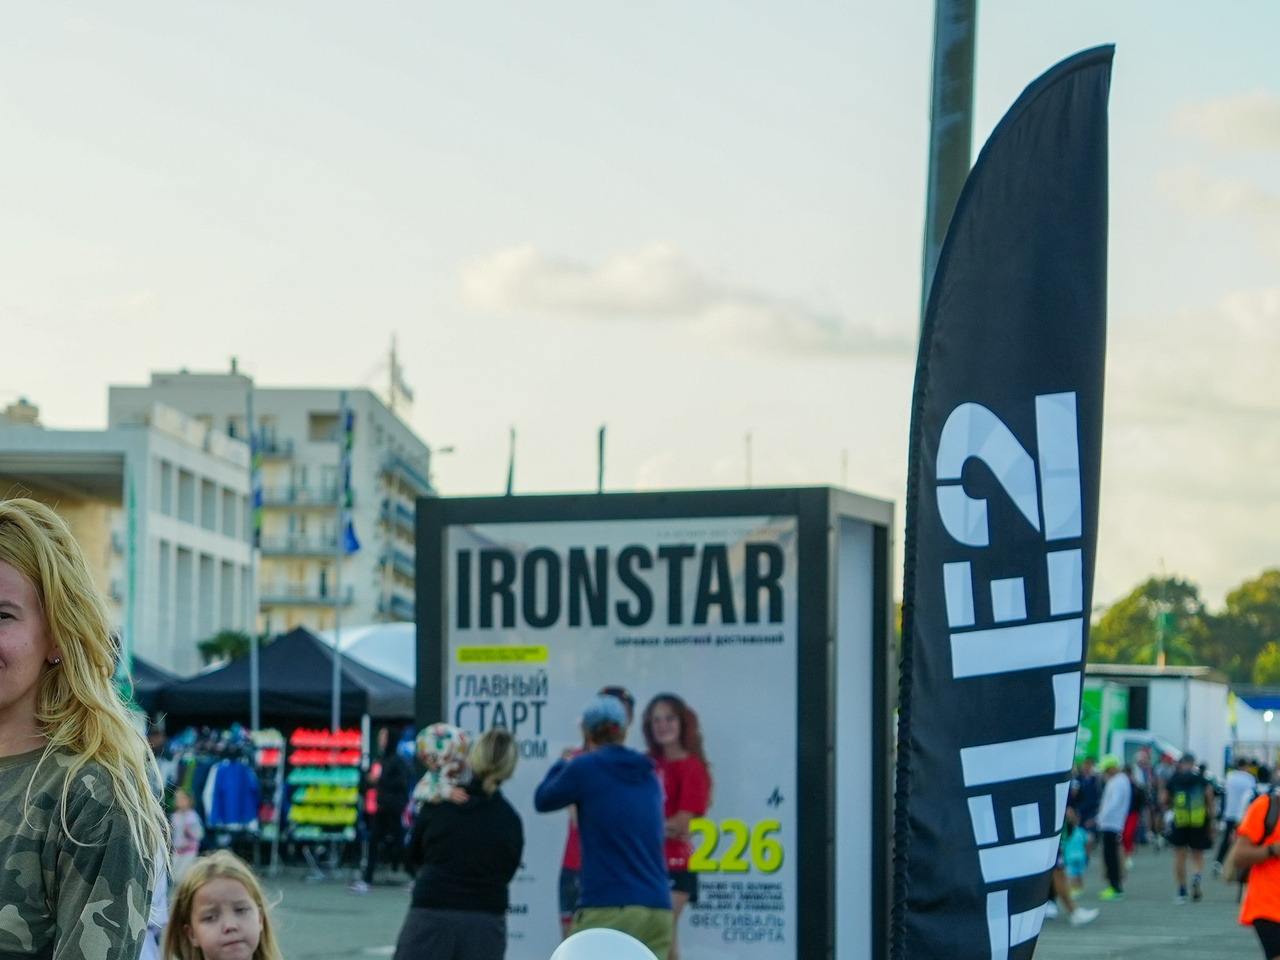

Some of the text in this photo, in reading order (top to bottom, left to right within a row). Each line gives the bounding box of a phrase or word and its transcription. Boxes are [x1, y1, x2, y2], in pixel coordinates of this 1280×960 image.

[457, 543, 785, 629] IRONSTAR
[455, 668, 548, 697] ГЛАВНЫЙ
[455, 701, 547, 735] СТАРТ
[688, 818, 783, 873] 226
[689, 913, 785, 929] ФЕСТИВАЛЬ
[722, 927, 785, 943] СПОРТА
